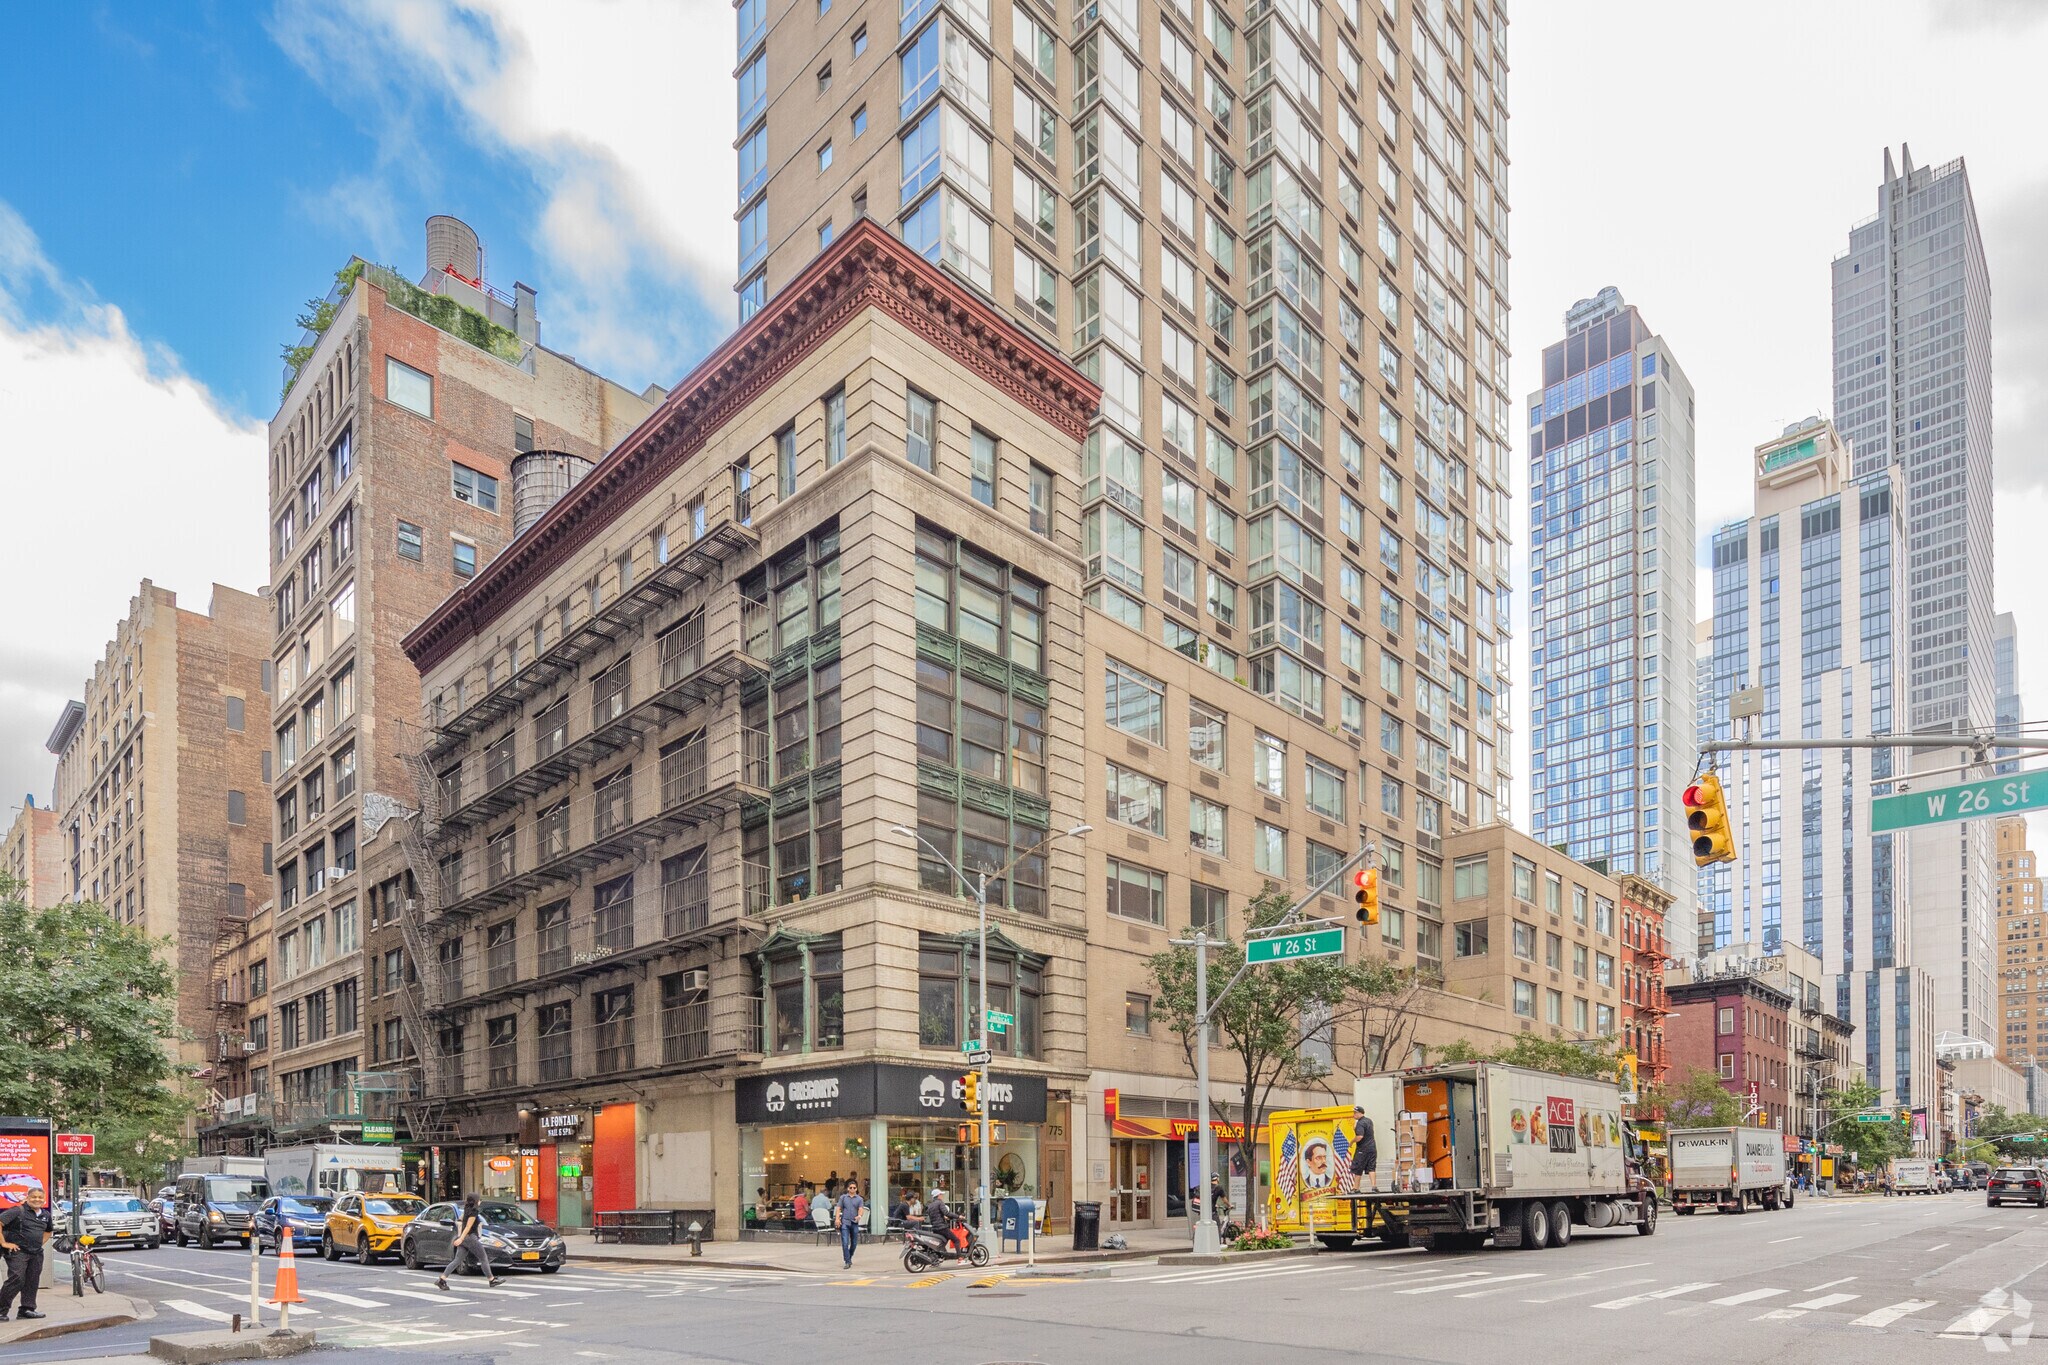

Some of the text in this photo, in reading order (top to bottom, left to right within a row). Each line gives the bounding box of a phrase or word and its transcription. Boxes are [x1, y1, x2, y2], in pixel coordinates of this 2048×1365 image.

[1927, 781, 2031, 818] W 26 St
[1272, 938, 1317, 956] W 26 St
[788, 1078, 839, 1101] GREGORYS
[796, 1101, 832, 1110] COFFEE
[1548, 1101, 1574, 1122] ACE
[541, 1118, 550, 1128] LA
[1049, 1125, 1063, 1136] 775
[1690, 1139, 1728, 1147] WALK-IN
[526, 1158, 534, 1198] NAILS
